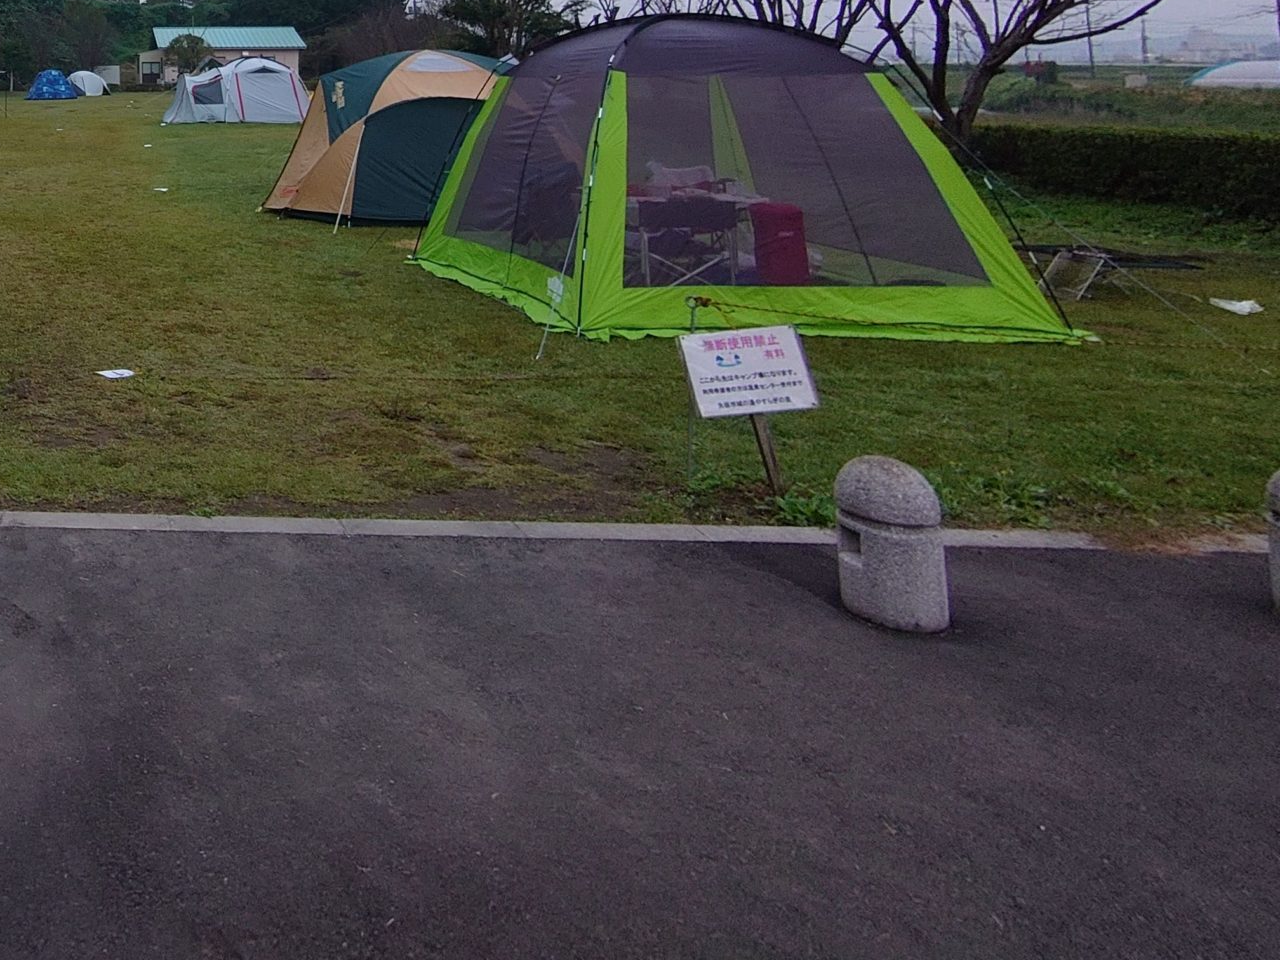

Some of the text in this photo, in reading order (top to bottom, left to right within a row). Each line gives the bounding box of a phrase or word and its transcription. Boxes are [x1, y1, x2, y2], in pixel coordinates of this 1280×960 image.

[702, 333, 780, 352] 無断使用禁止
